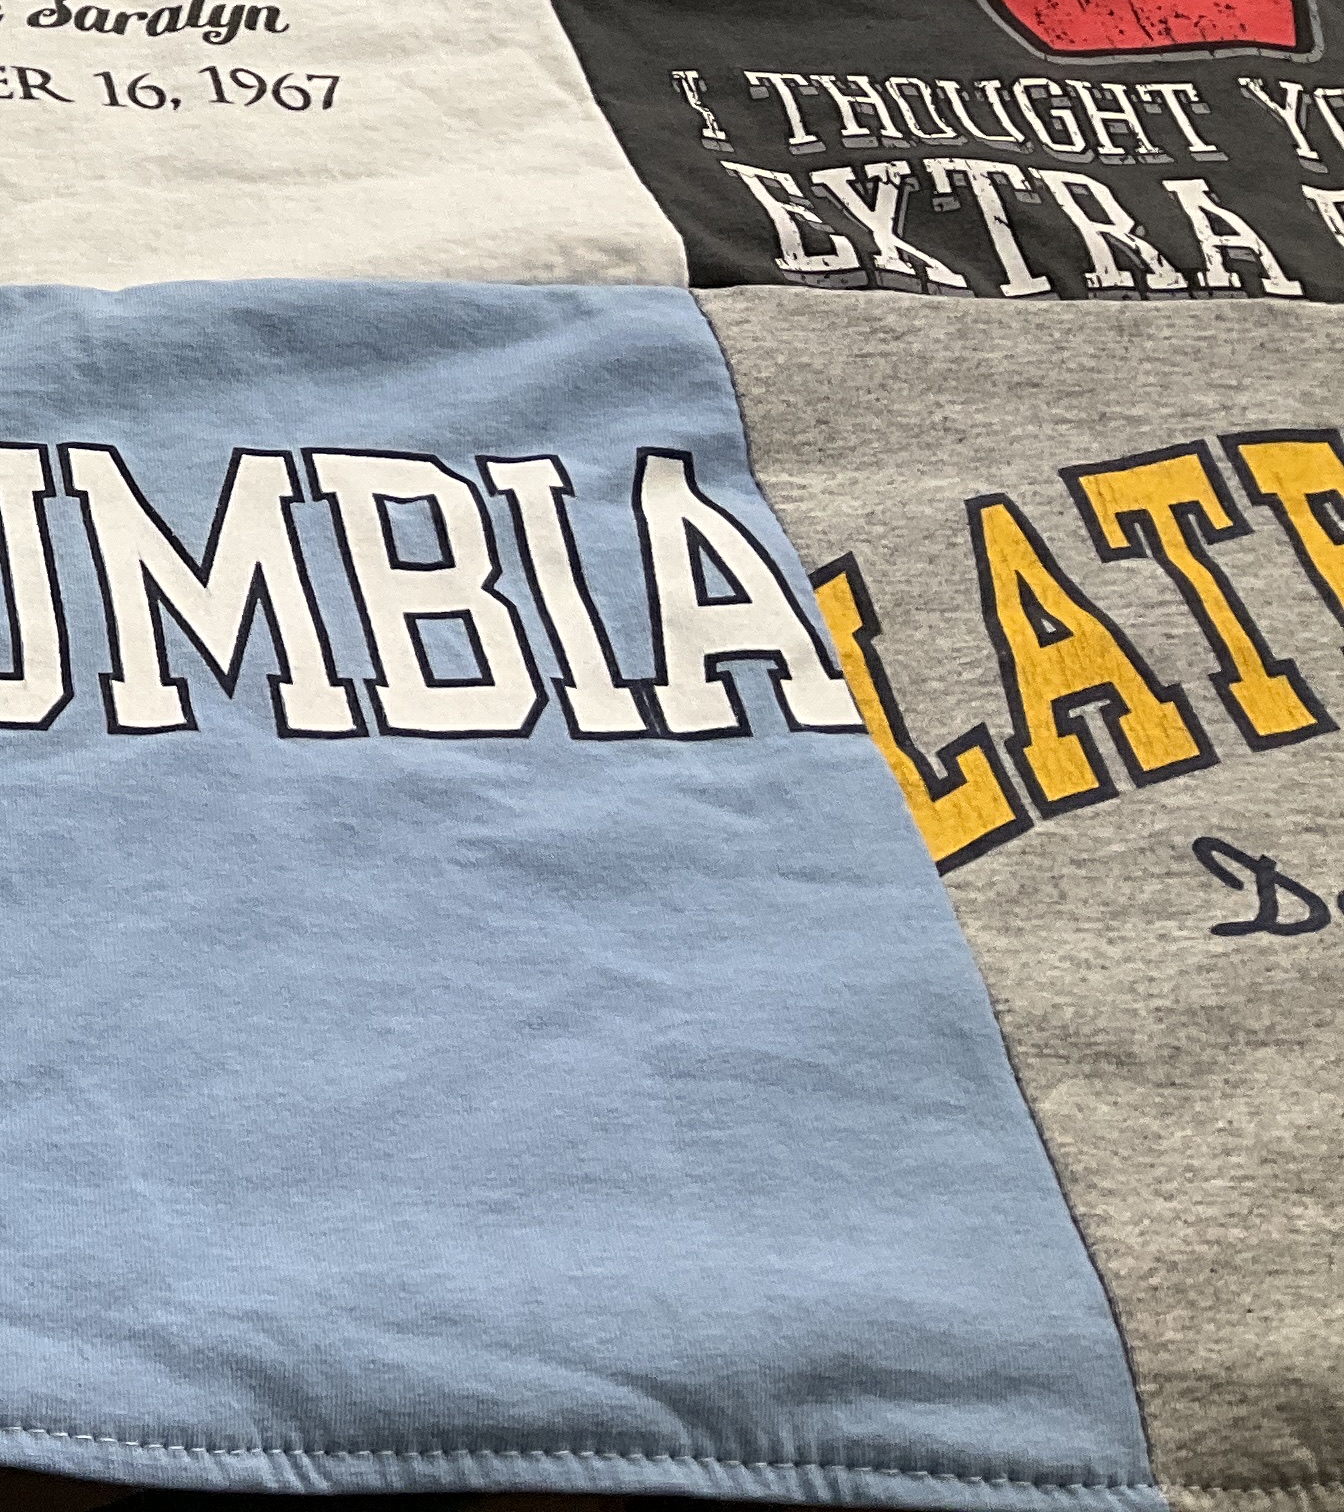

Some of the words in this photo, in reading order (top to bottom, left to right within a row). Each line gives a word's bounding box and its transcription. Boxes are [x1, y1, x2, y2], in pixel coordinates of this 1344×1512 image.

[100, 69, 183, 113] 16,
[207, 64, 342, 113] 1967
[672, 69, 735, 152] I
[744, 68, 1230, 166] THOUGHT
[720, 154, 1305, 299] EXTRA
